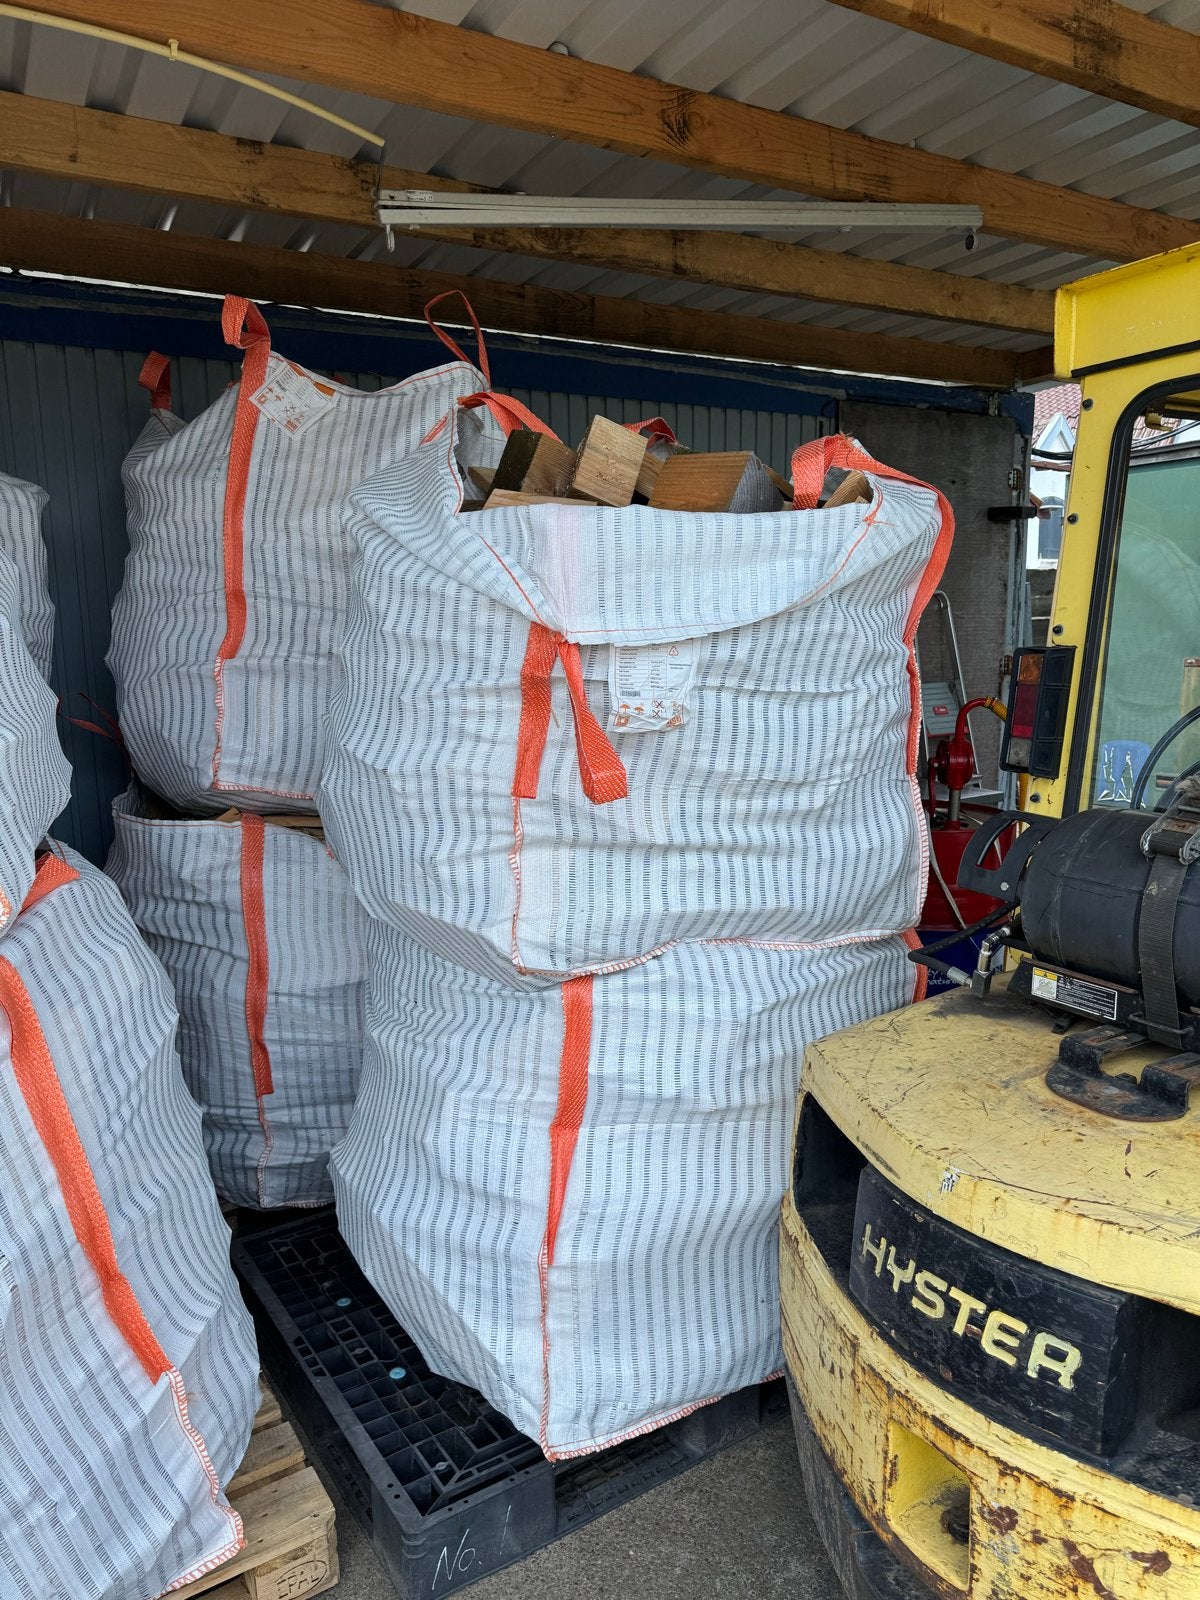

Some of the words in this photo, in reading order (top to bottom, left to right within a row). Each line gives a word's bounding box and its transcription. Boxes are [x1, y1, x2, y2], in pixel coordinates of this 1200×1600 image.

[862, 1223, 1082, 1390] HYSTER
[276, 1569, 320, 1599] EPAL
[431, 1528, 482, 1590] No.
